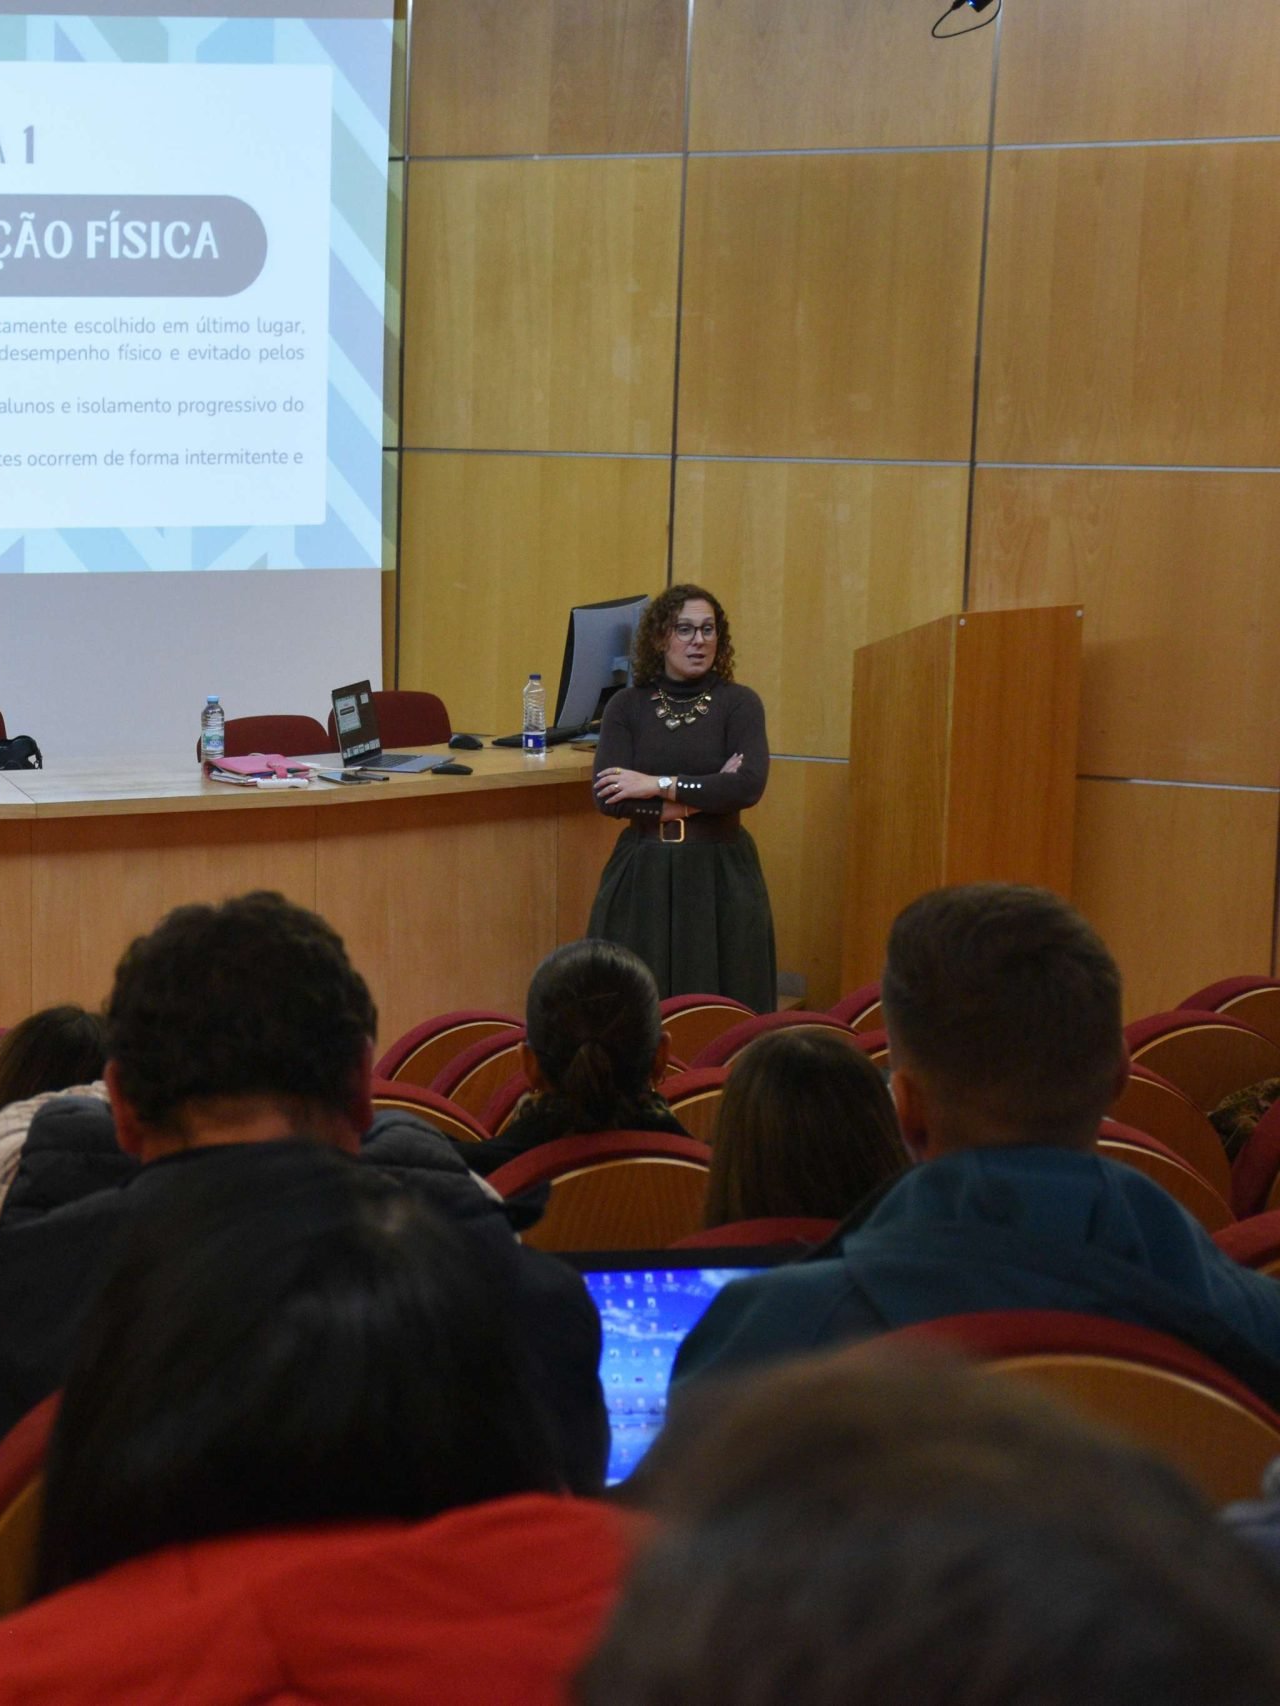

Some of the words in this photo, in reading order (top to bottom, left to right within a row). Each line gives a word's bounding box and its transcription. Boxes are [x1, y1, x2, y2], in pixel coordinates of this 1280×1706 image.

[22, 125, 34, 163] 1
[87, 210, 218, 259] FÍSICA
[74, 317, 156, 334] escolhido
[163, 321, 189, 333] em
[196, 315, 250, 334] último
[257, 317, 304, 337] lugar,
[118, 343, 162, 360] físico
[170, 348, 180, 360] e
[188, 344, 251, 360] evitado
[259, 344, 304, 363] pelos
[61, 401, 71, 414] e
[77, 397, 172, 413] isolamento
[178, 396, 277, 416] progressivo
[282, 396, 304, 412] do
[27, 453, 97, 467] ocorrem
[104, 449, 124, 466] de
[129, 448, 179, 466] forma
[185, 448, 289, 465] intermitente
[293, 452, 303, 464] e
